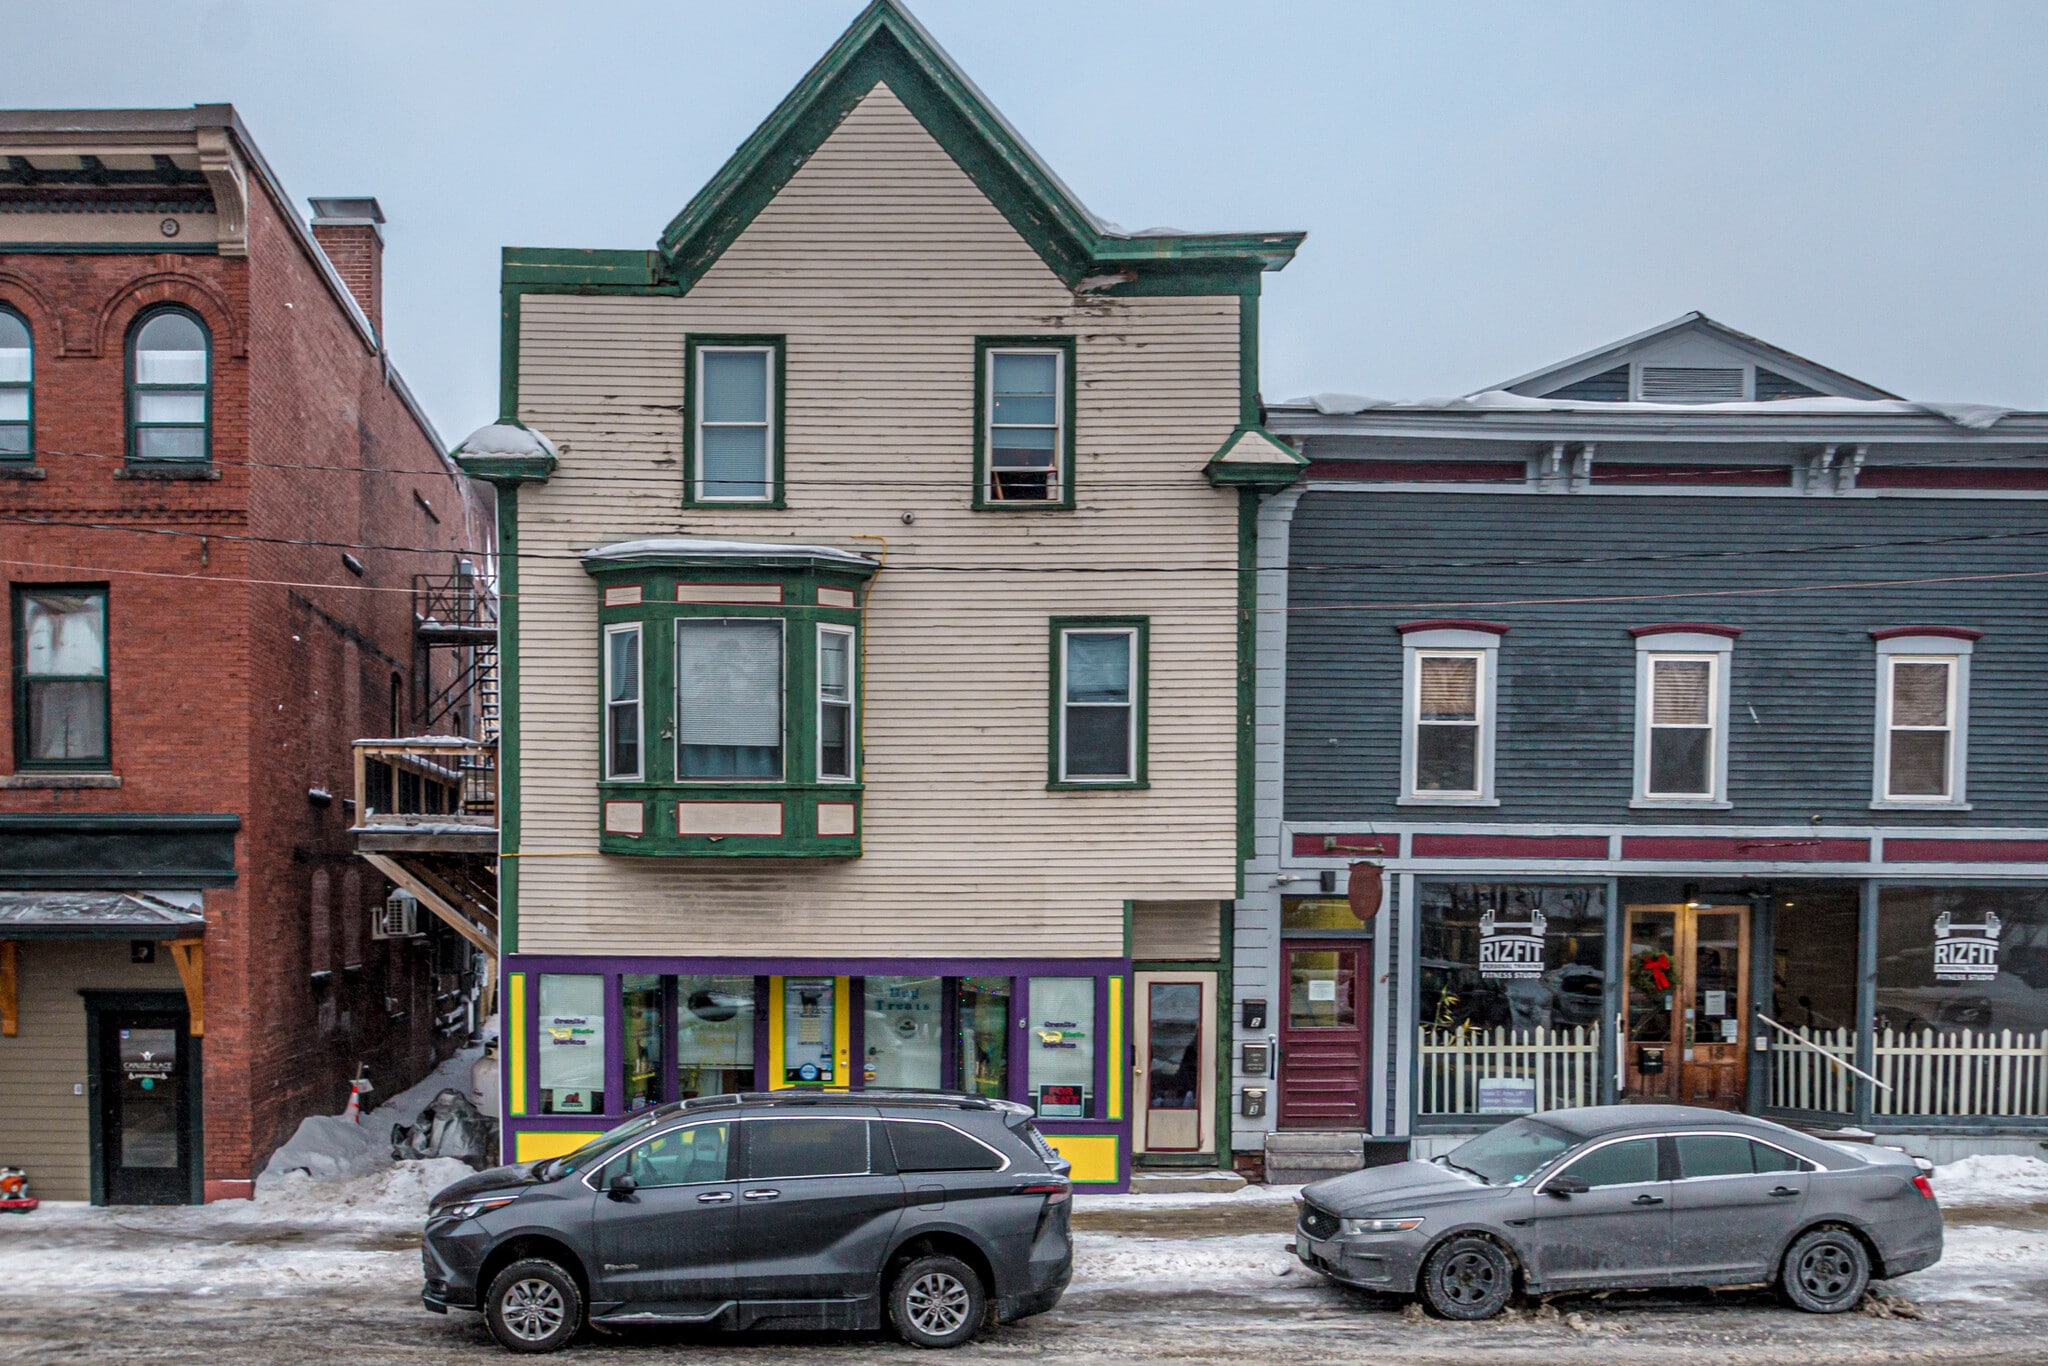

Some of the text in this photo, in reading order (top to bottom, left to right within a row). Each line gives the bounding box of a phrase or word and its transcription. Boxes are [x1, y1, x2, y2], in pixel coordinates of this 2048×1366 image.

[1480, 941, 1545, 962] RIZFIT
[1935, 943, 1999, 964] RIZFIT
[875, 1000, 930, 1011] Treats
[1048, 1087, 1074, 1096] FOR
[1042, 1095, 1080, 1105] RENT
